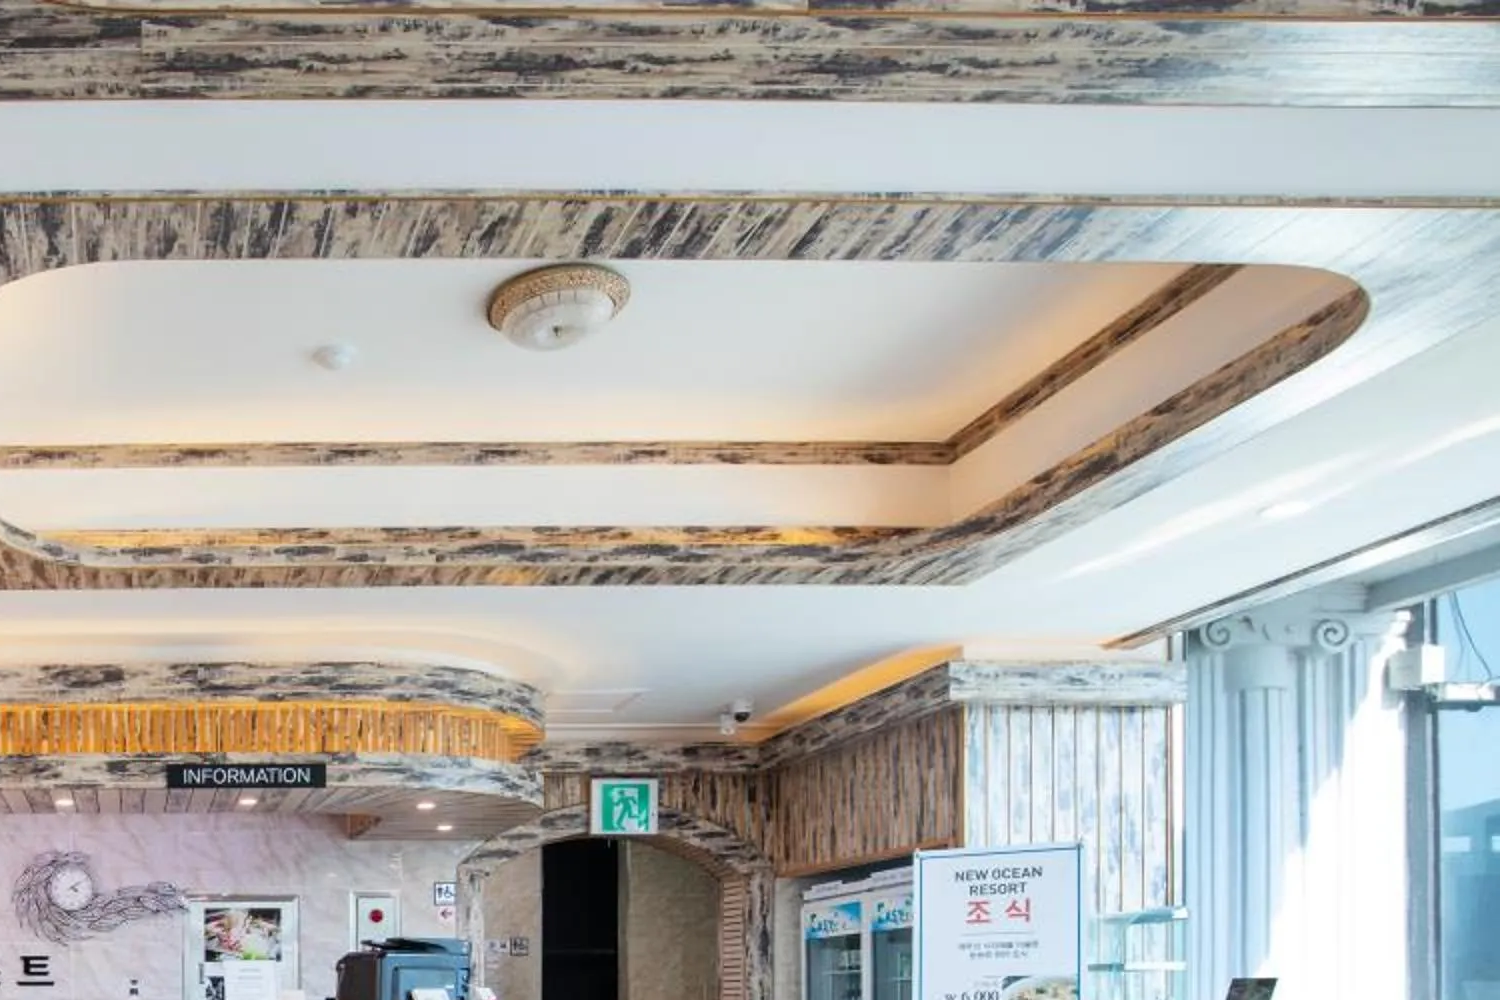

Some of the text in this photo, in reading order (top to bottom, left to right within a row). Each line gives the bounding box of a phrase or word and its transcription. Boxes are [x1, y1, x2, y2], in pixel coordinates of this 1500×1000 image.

[183, 767, 311, 785] INFORMATION
[955, 866, 1043, 882] NEW OCEAN
[969, 882, 1027, 897] RESORT
